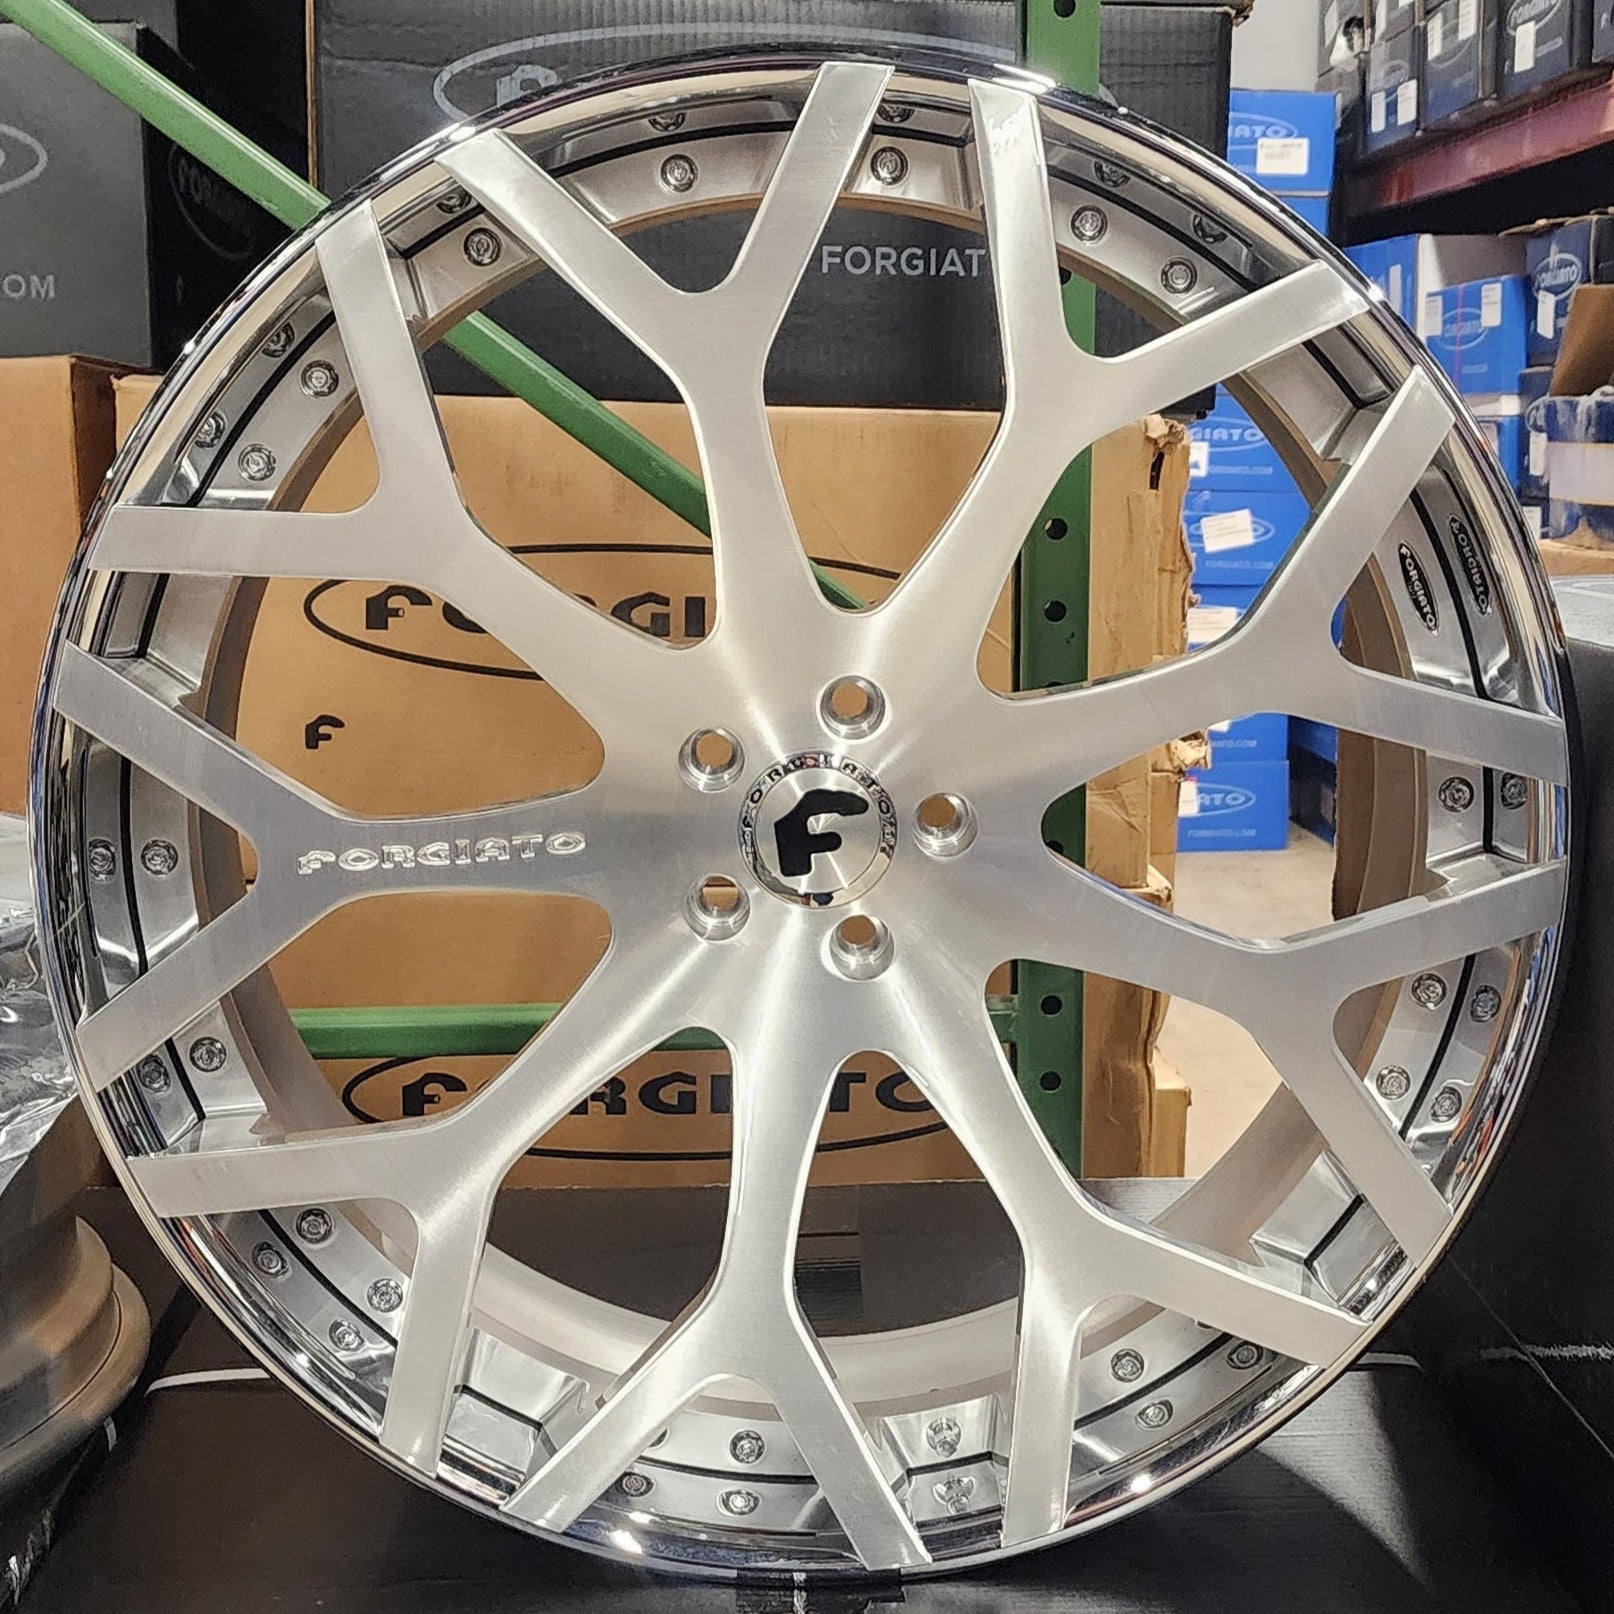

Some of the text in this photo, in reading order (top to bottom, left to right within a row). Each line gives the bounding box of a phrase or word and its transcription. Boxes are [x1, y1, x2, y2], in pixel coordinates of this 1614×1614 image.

[821, 245, 986, 277] FORGIAT
[1400, 545, 1435, 627] FORGIATO
[305, 715, 345, 750] F
[298, 833, 586, 875] FORGIATO
[774, 788, 869, 877] F
[402, 1071, 933, 1116] FRGITO
